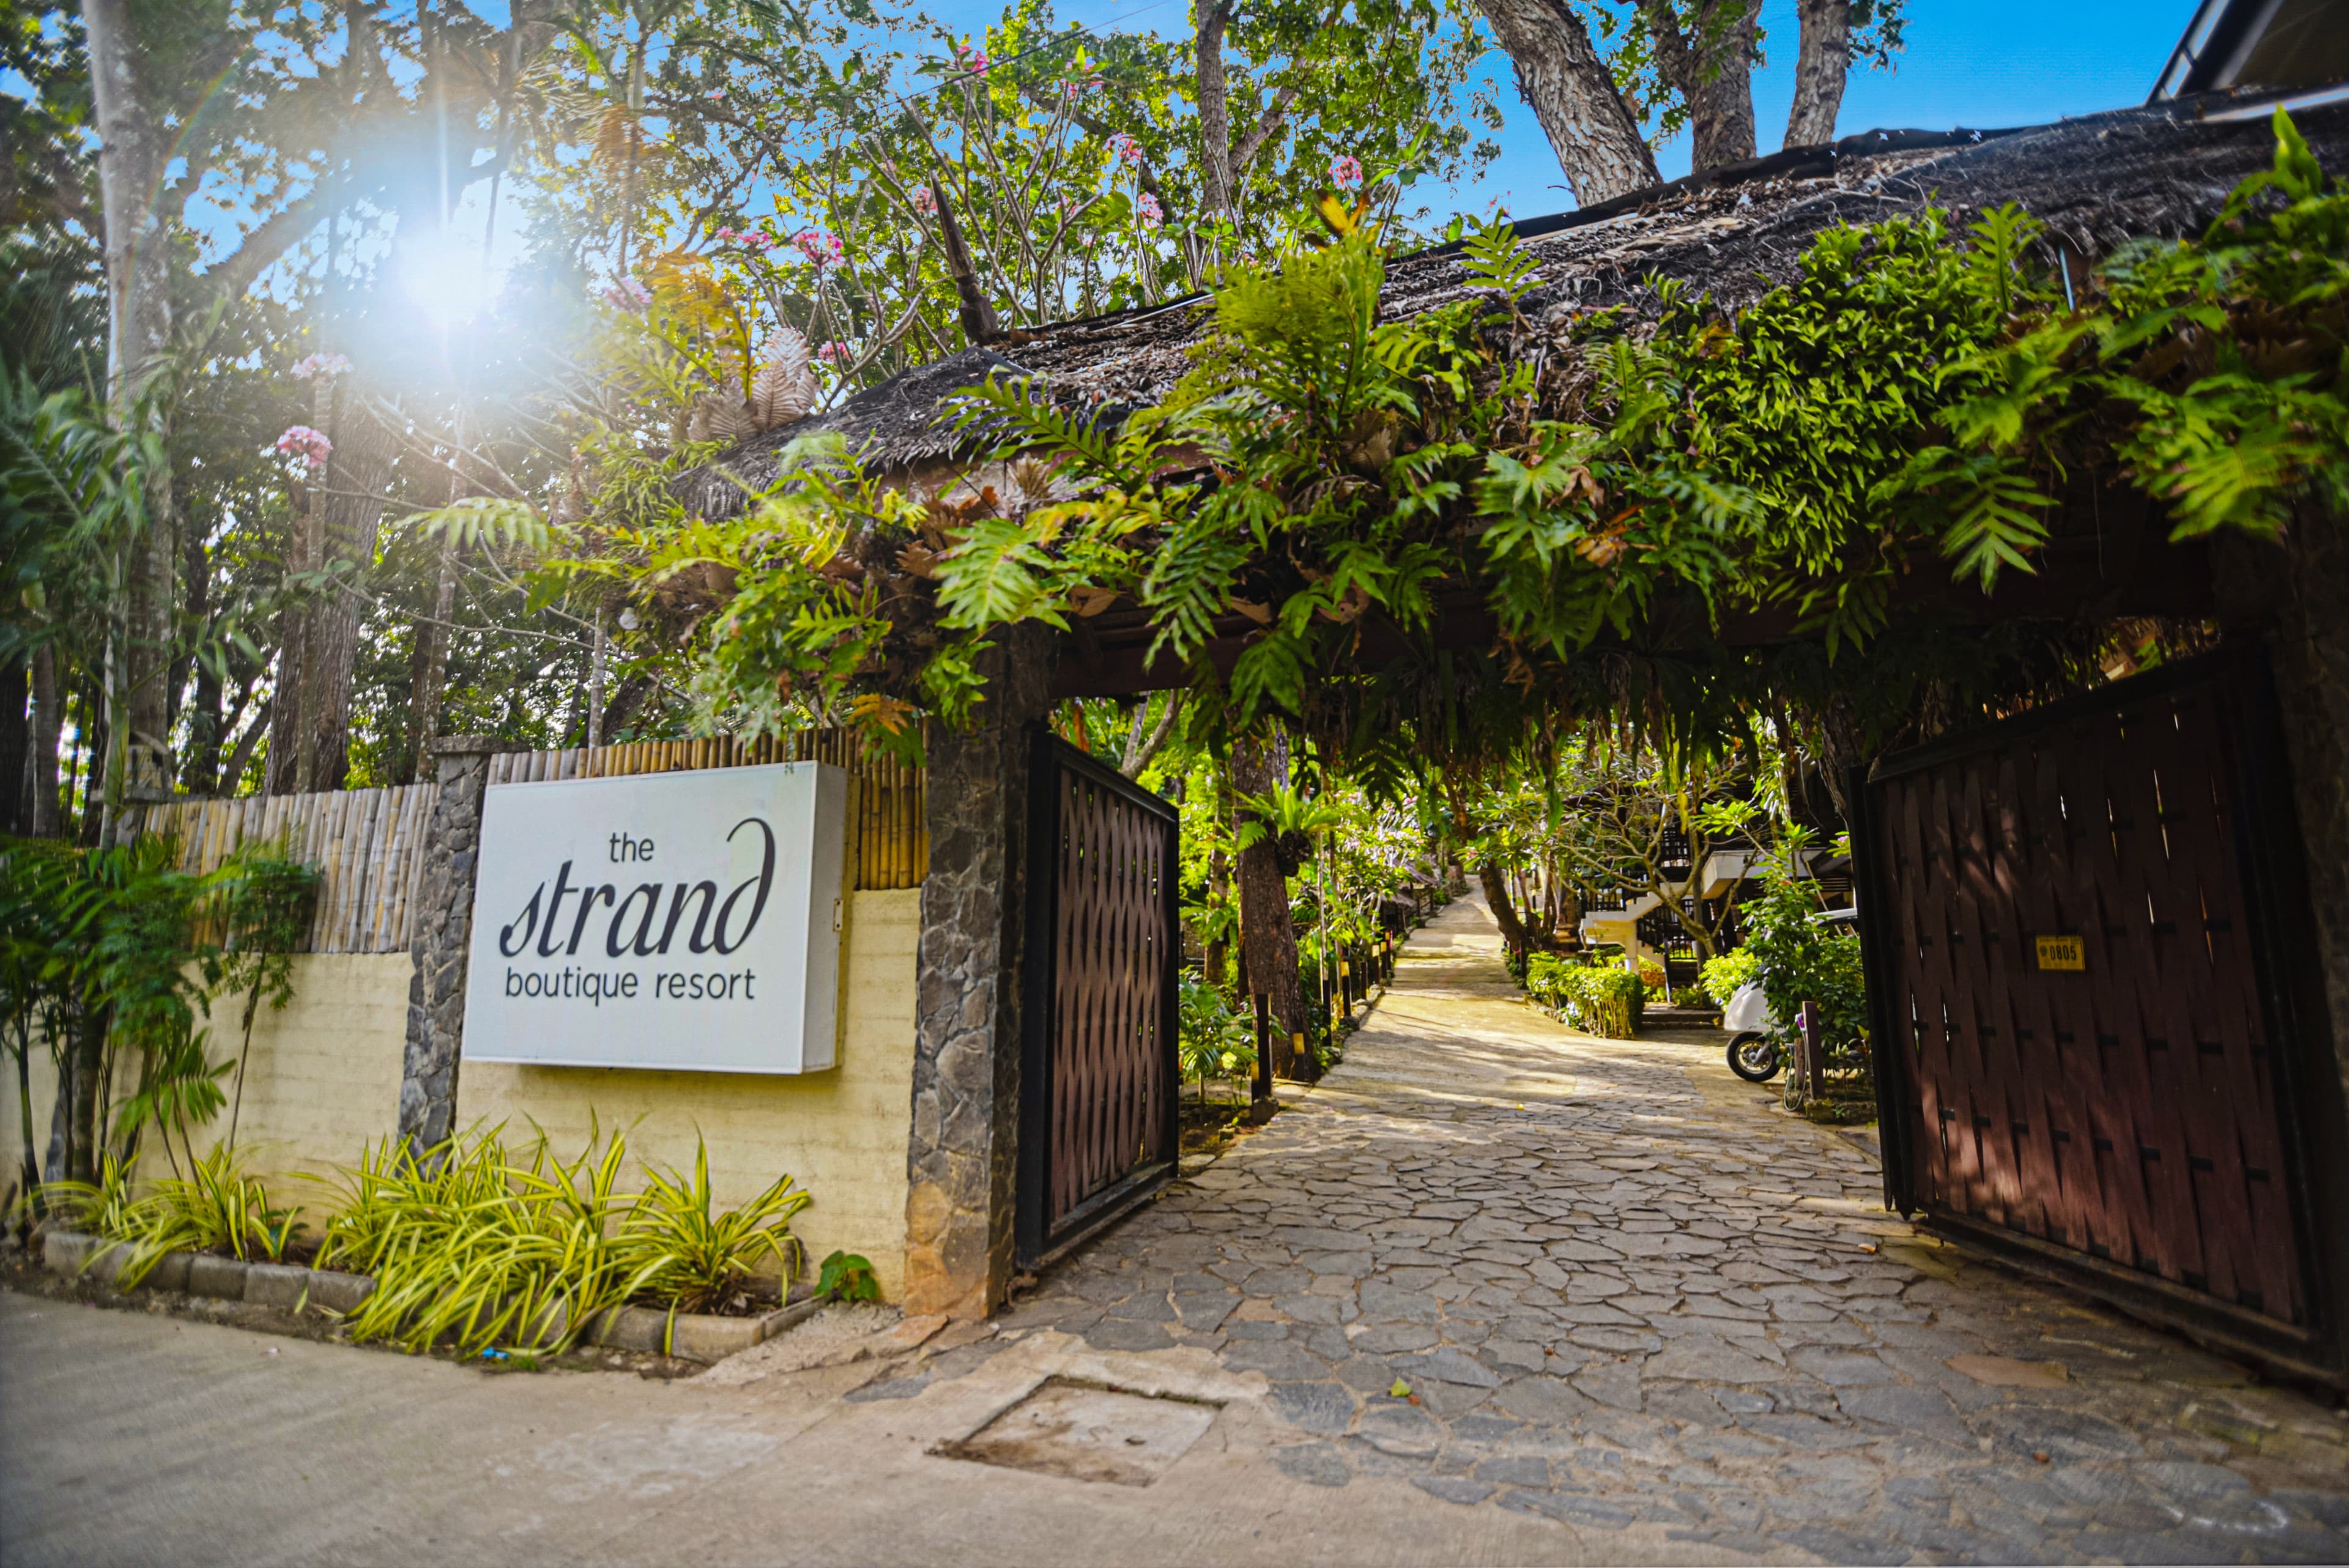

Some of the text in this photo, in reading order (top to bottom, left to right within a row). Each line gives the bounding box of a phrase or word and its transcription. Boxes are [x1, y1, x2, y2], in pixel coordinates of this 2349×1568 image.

[609, 831, 655, 863] the
[499, 817, 776, 958] strand
[2050, 945, 2077, 960] 0805
[505, 967, 756, 1007] boutique resort
